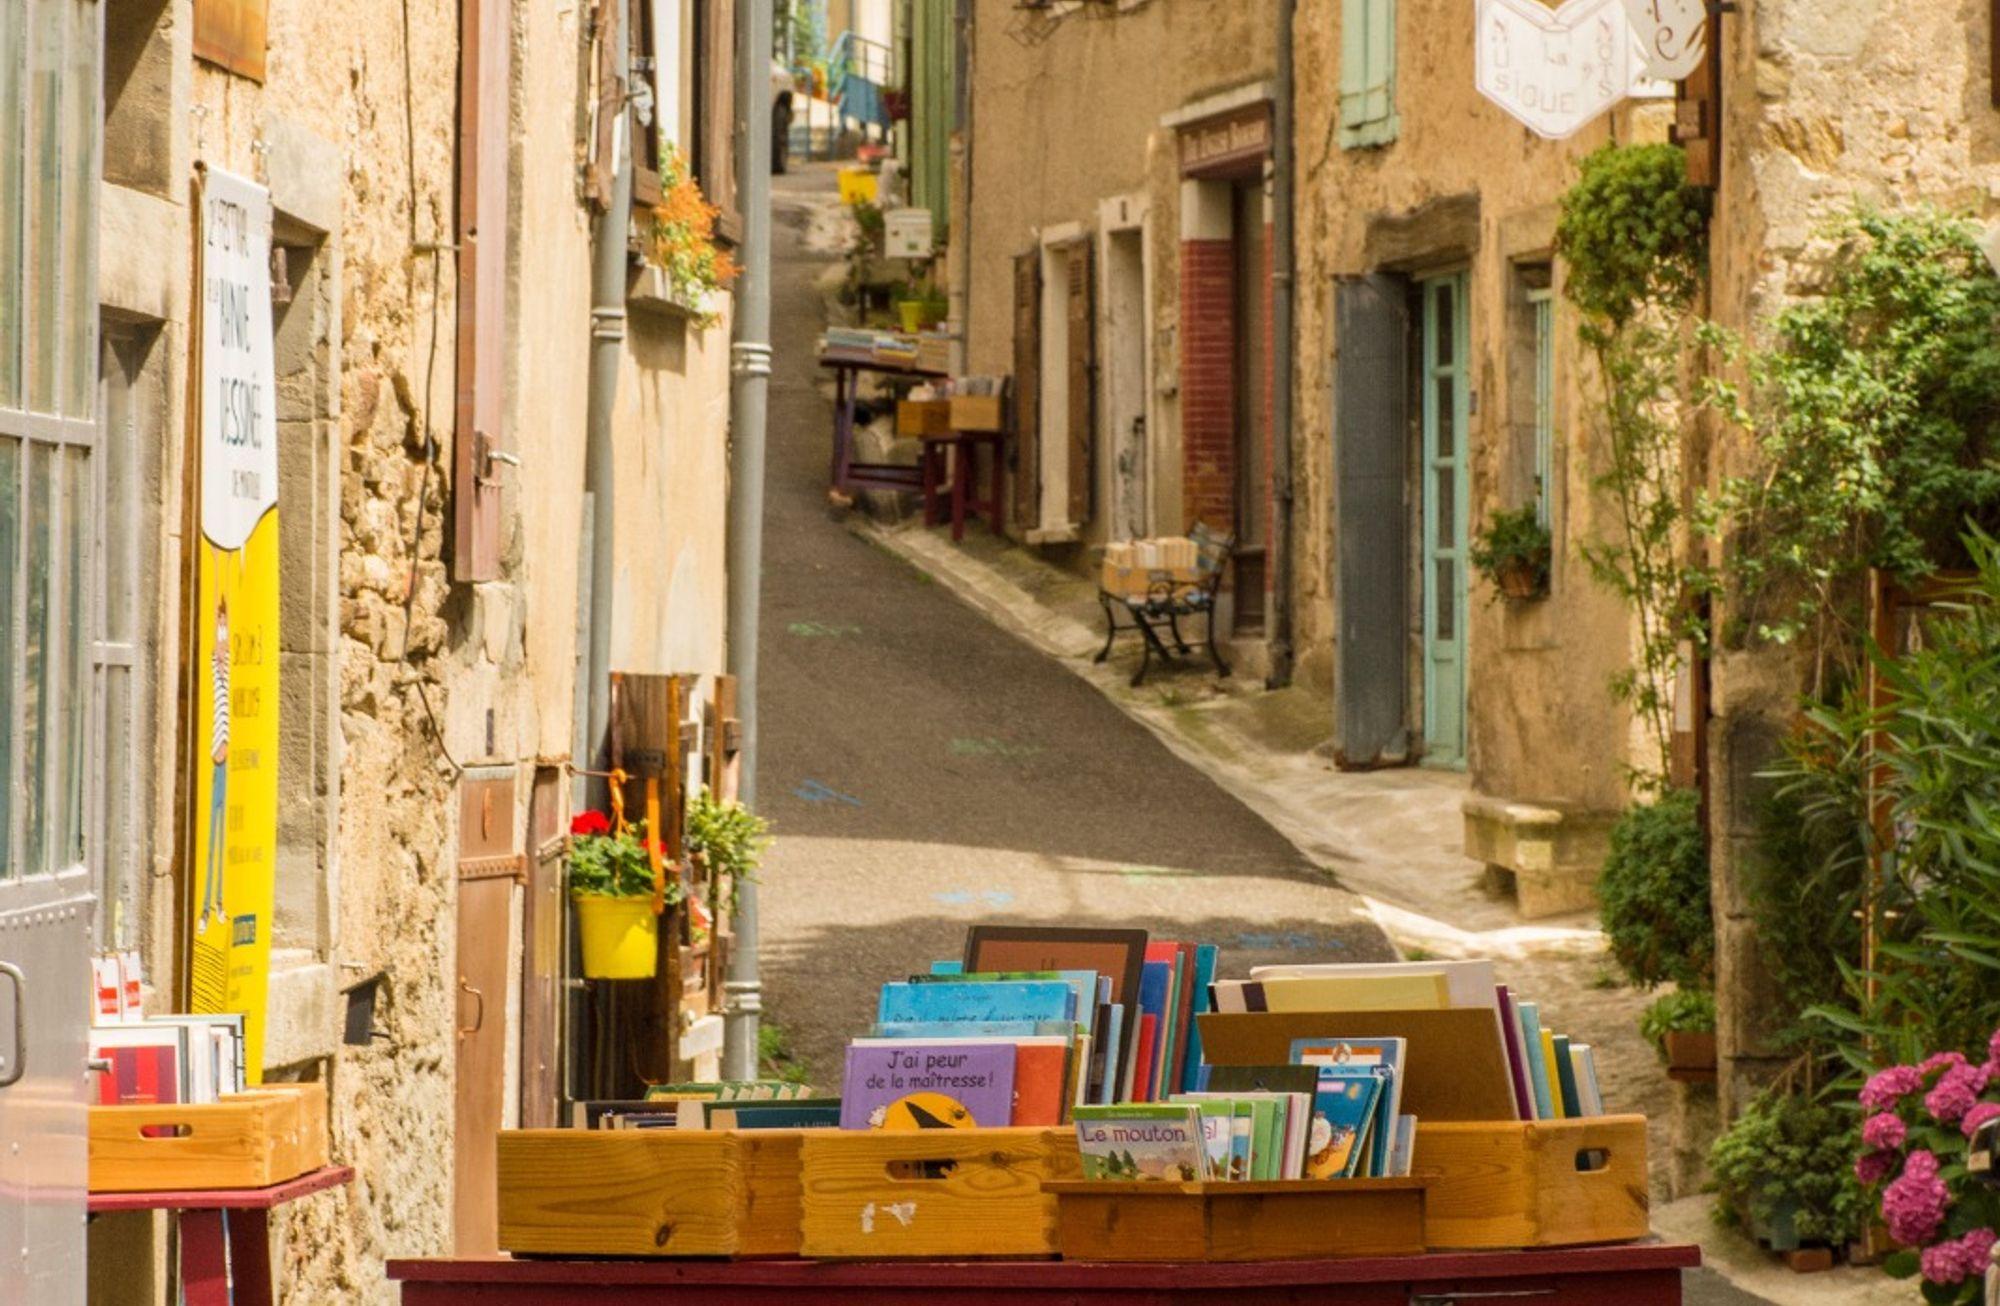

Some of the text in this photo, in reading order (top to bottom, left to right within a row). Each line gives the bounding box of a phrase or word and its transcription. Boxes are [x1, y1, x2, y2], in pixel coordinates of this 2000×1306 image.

[887, 1050, 968, 1073] J'ai peur
[866, 1073, 885, 1089] de
[891, 1072, 904, 1088] la
[1080, 1120, 1186, 1142] Le mouton
